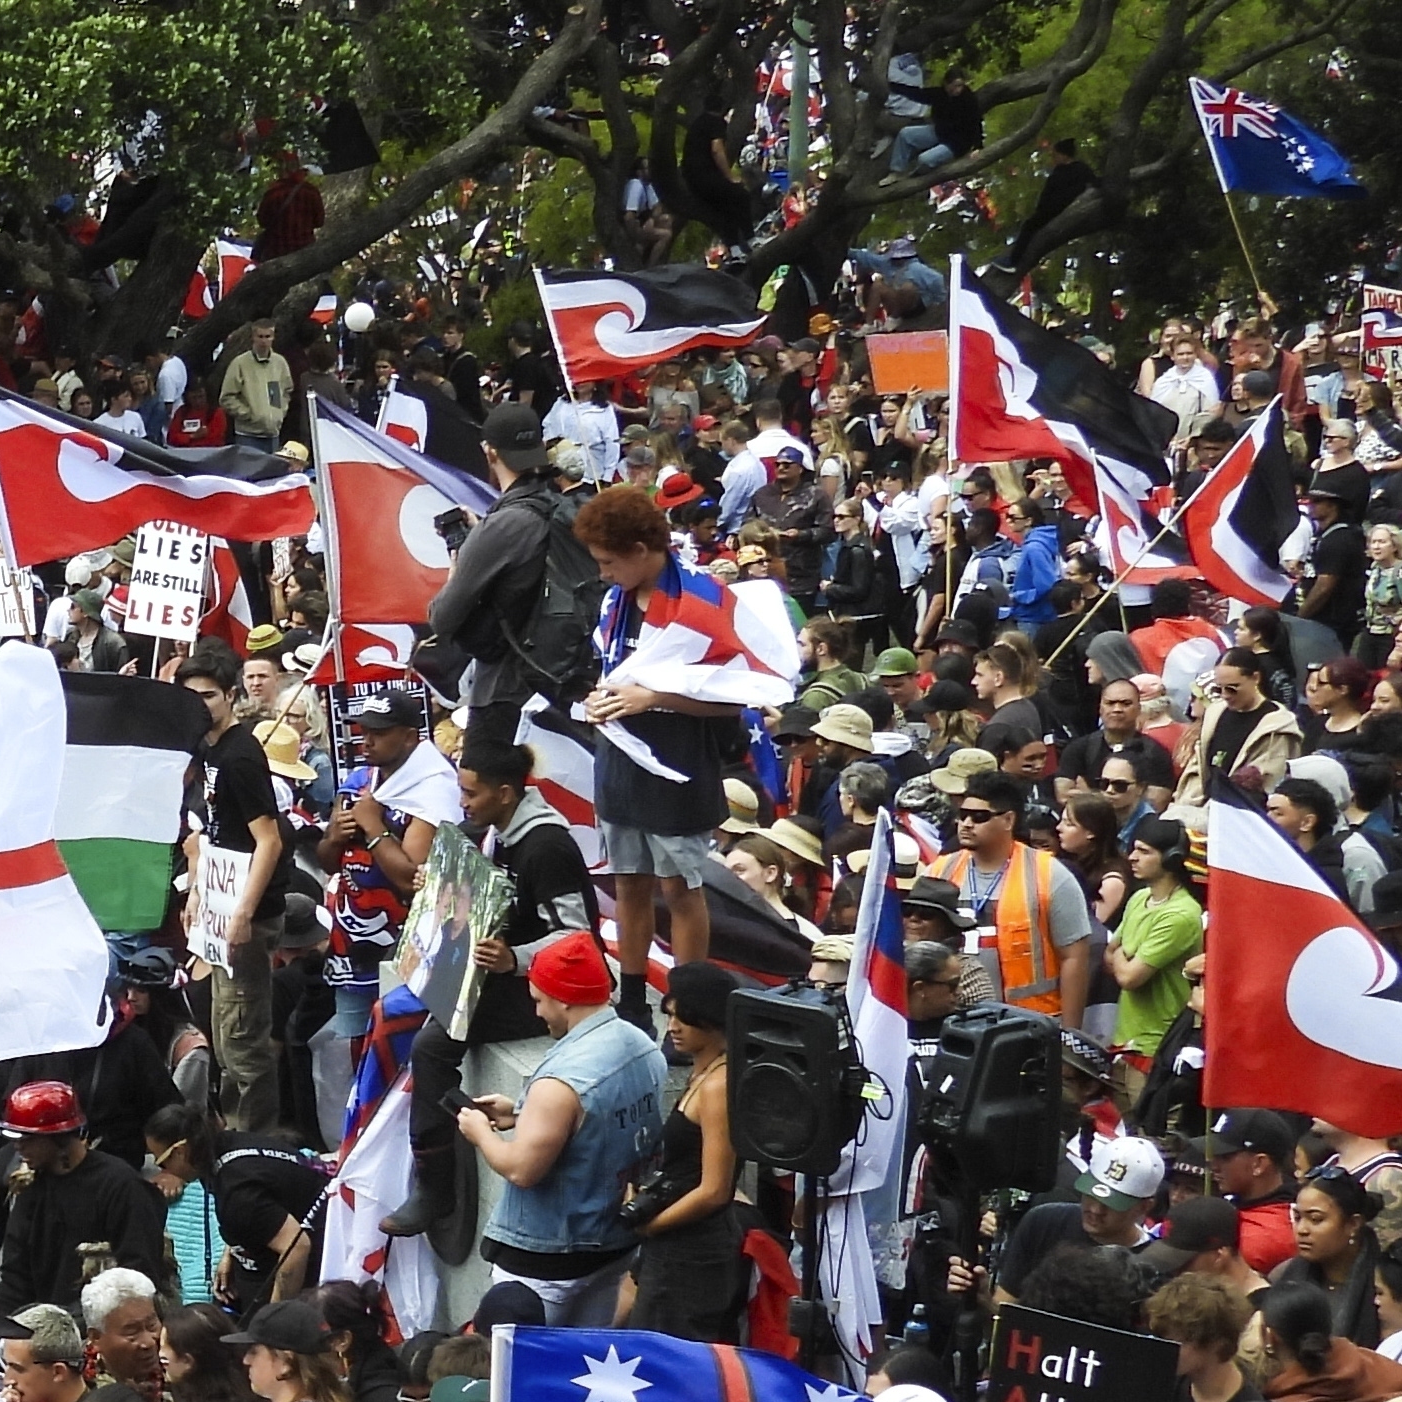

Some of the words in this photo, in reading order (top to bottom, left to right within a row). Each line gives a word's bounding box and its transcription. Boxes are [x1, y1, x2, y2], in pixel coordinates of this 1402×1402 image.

[138, 533, 203, 565] LIES
[132, 568, 160, 587] ARE
[161, 574, 201, 595] STILL
[128, 598, 195, 627] LIES
[1006, 1328, 1102, 1388] Halt
